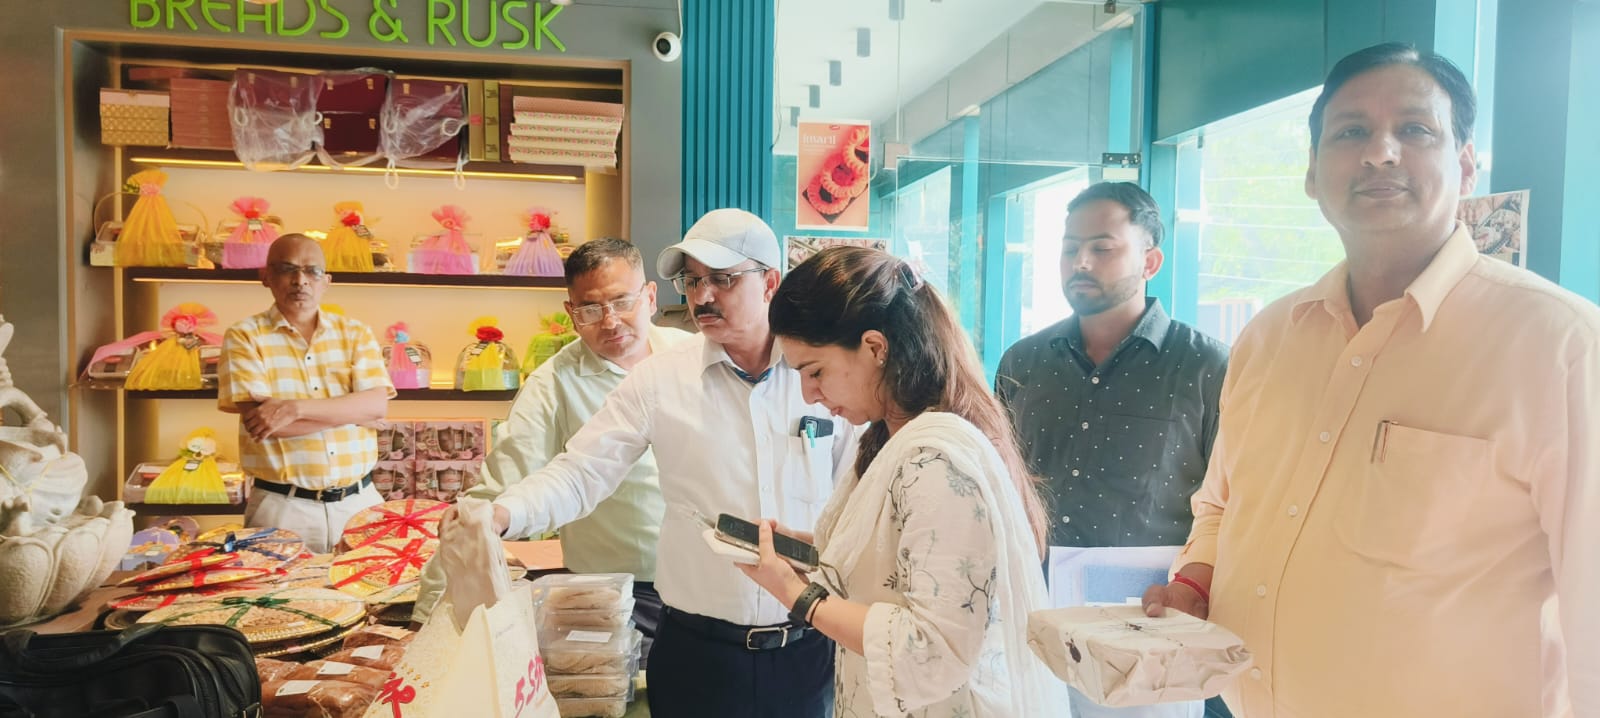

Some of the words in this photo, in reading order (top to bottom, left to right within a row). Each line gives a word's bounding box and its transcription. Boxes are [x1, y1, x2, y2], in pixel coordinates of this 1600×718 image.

[130, 0, 349, 39] BREADS
[368, 0, 409, 42] &
[427, 0, 567, 52] RUSK
